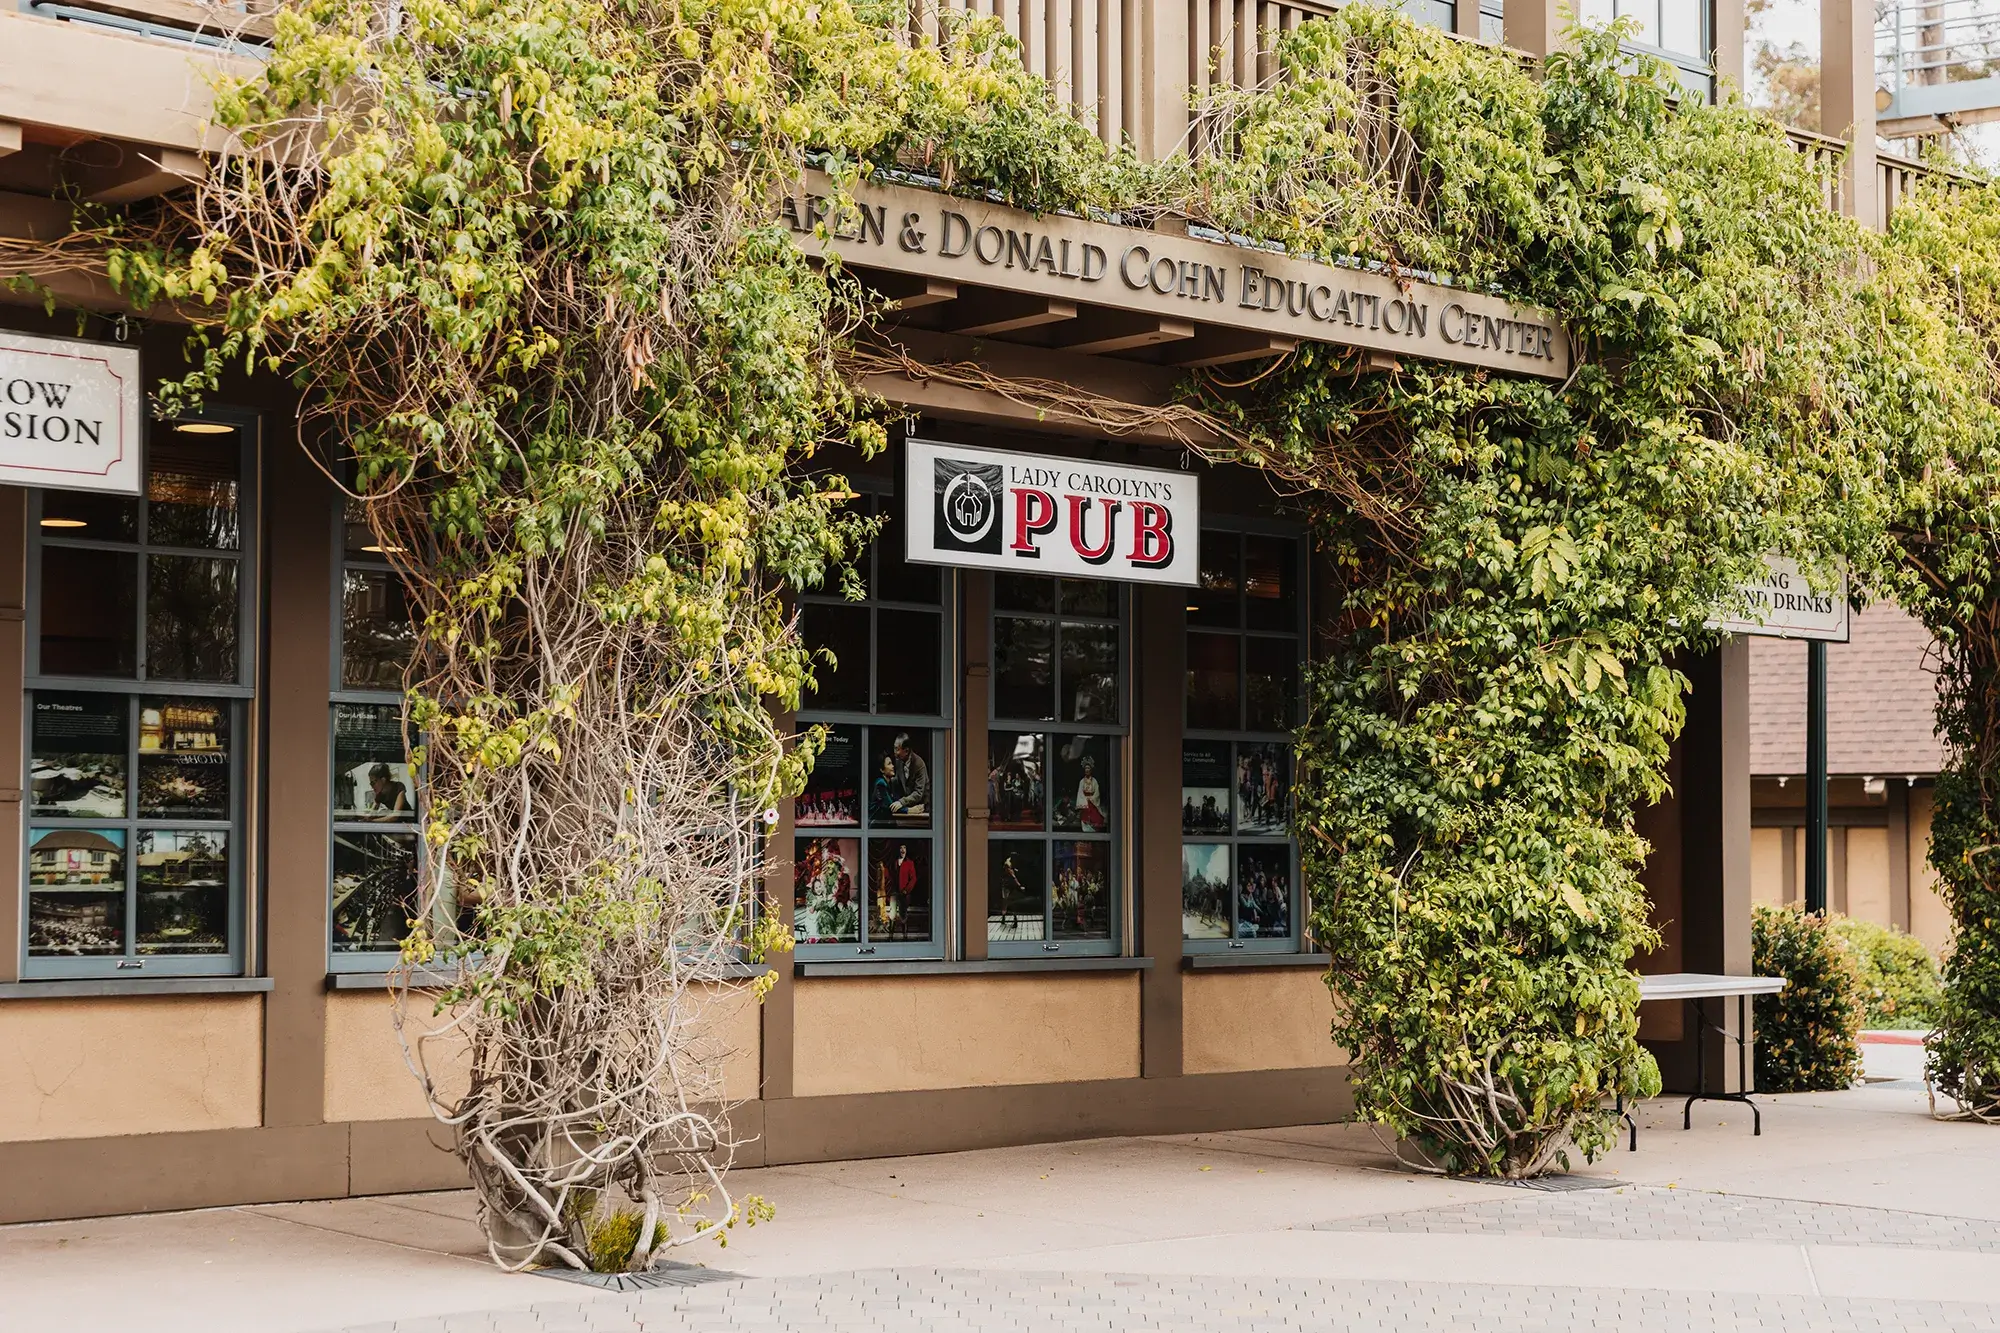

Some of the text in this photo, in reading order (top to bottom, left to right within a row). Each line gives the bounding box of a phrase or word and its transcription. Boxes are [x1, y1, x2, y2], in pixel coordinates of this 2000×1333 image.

[900, 211, 927, 254] &
[938, 209, 1107, 283] DONALD
[1120, 244, 1227, 303] COHN
[1238, 264, 1429, 339] EDUCATION
[1438, 302, 1555, 362] CENTER
[1010, 465, 1172, 501] LADY CAROLYN'S
[1010, 488, 1175, 570] PUB
[1773, 592, 1833, 614] DRINKS
[36, 703, 83, 712] Our Theatres
